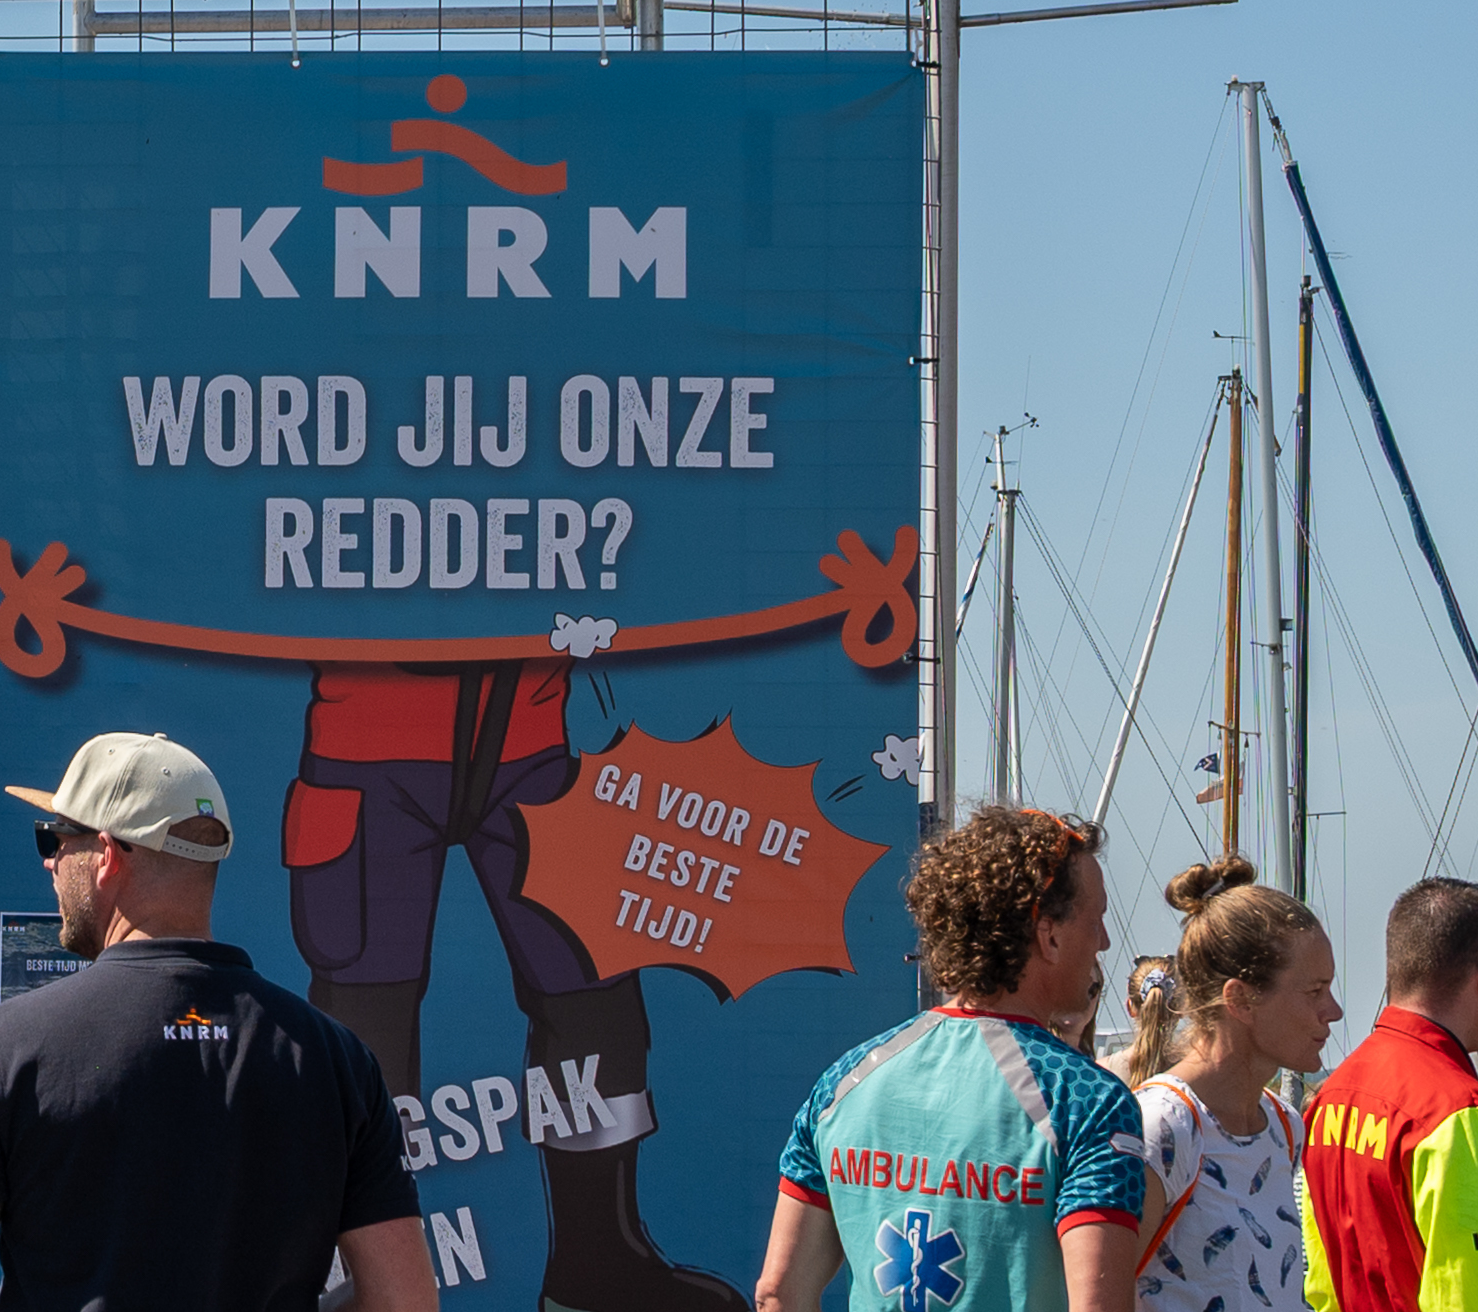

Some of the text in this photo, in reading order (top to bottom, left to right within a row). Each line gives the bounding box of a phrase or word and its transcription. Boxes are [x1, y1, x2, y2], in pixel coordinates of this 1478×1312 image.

[209, 206, 687, 299] KNRM
[122, 374, 775, 469] WORD JIJ ONZE
[264, 497, 633, 590] REDDER?
[594, 764, 811, 866] GA VOOR DE
[624, 833, 741, 904] BESTE
[615, 889, 713, 954] TIJD!
[26, 958, 54, 972] BESTE
[56, 959, 77, 973] TIJD
[163, 1024, 230, 1040] KNRM
[830, 1146, 1045, 1206] AMBULANCE
